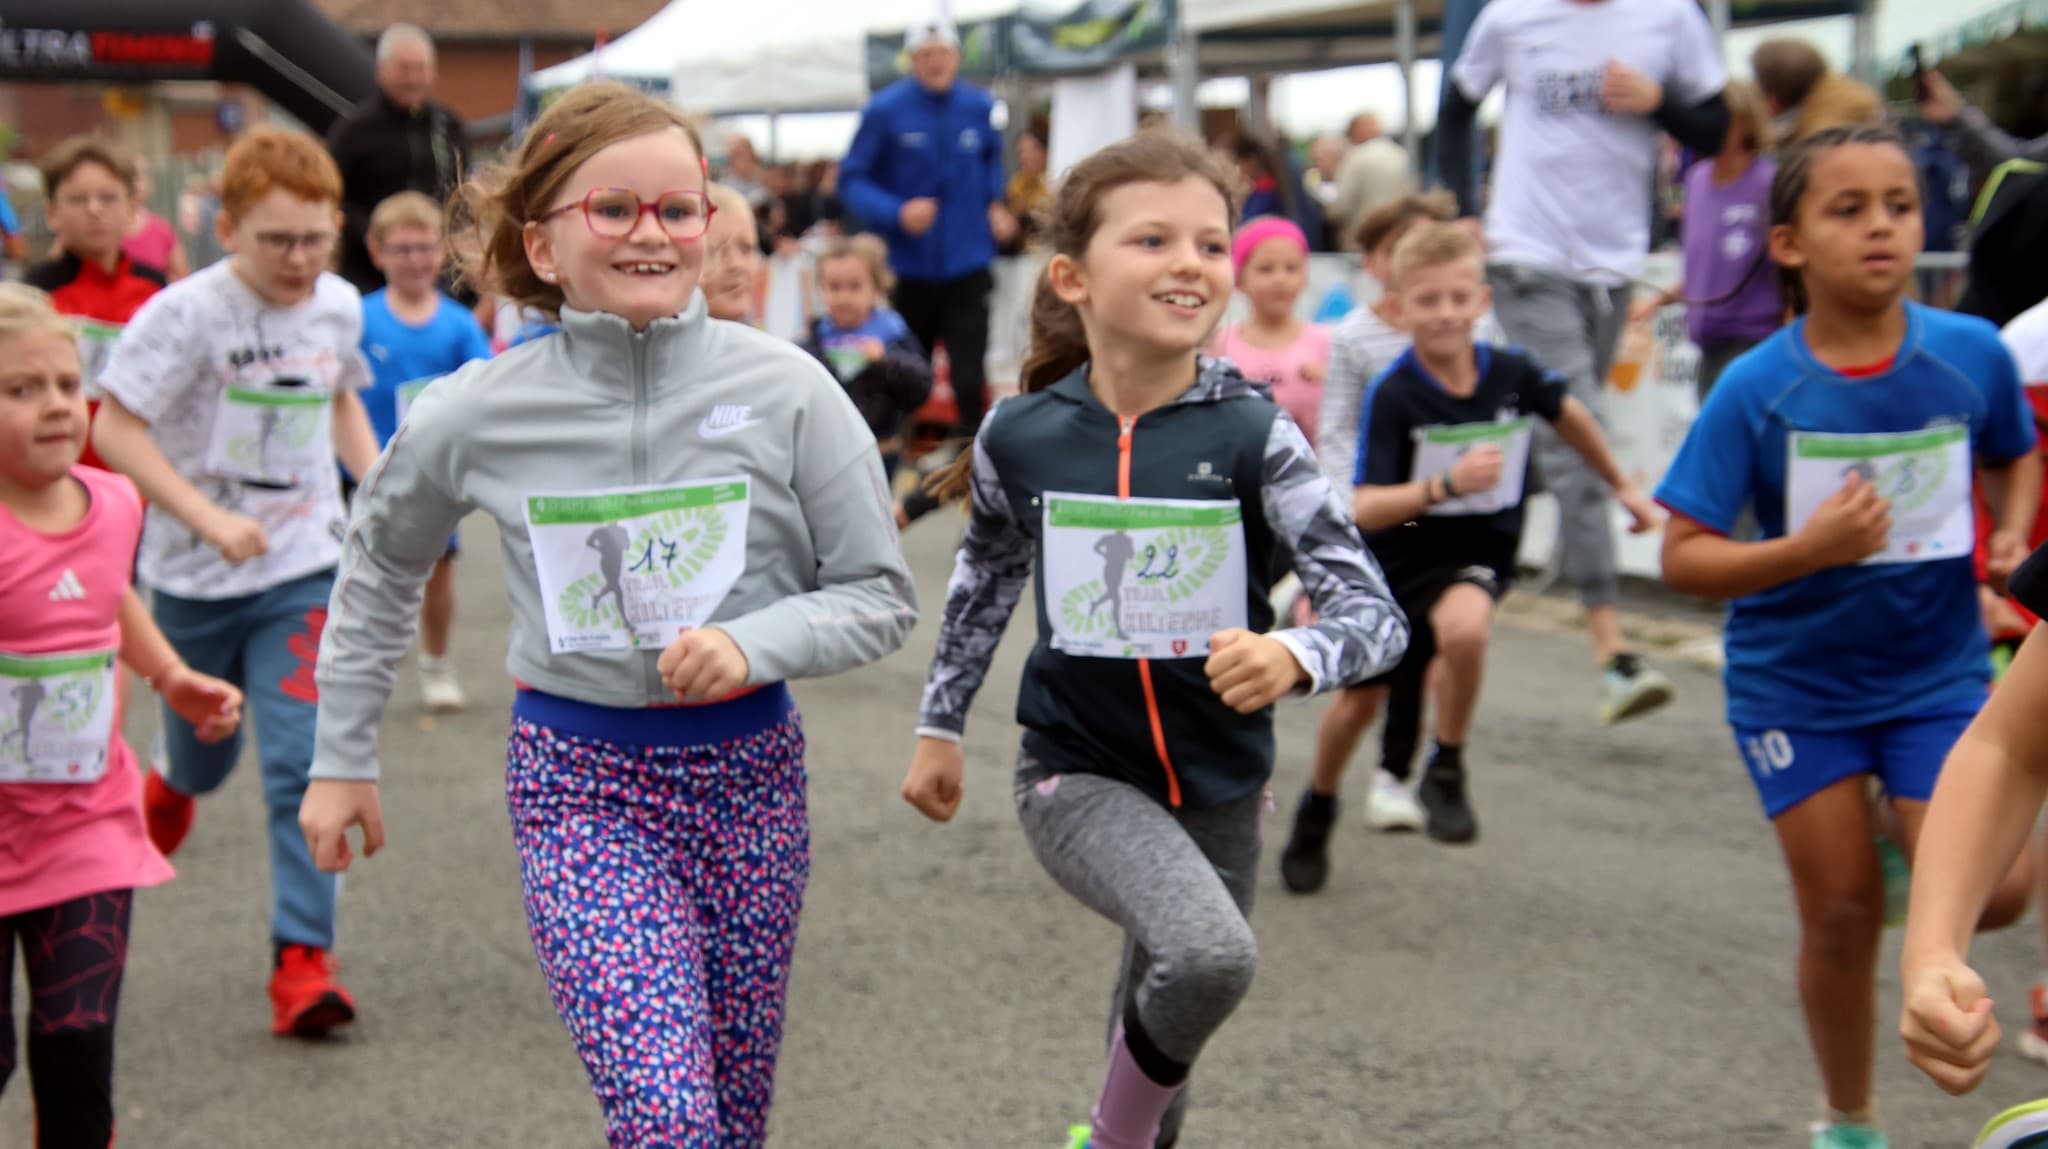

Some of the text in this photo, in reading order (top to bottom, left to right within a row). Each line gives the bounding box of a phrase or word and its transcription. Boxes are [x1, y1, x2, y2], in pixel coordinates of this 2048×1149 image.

[708, 404, 751, 425] NIKE
[628, 537, 677, 572] 17
[1136, 544, 1180, 578] 22
[1749, 729, 1795, 778] 10
